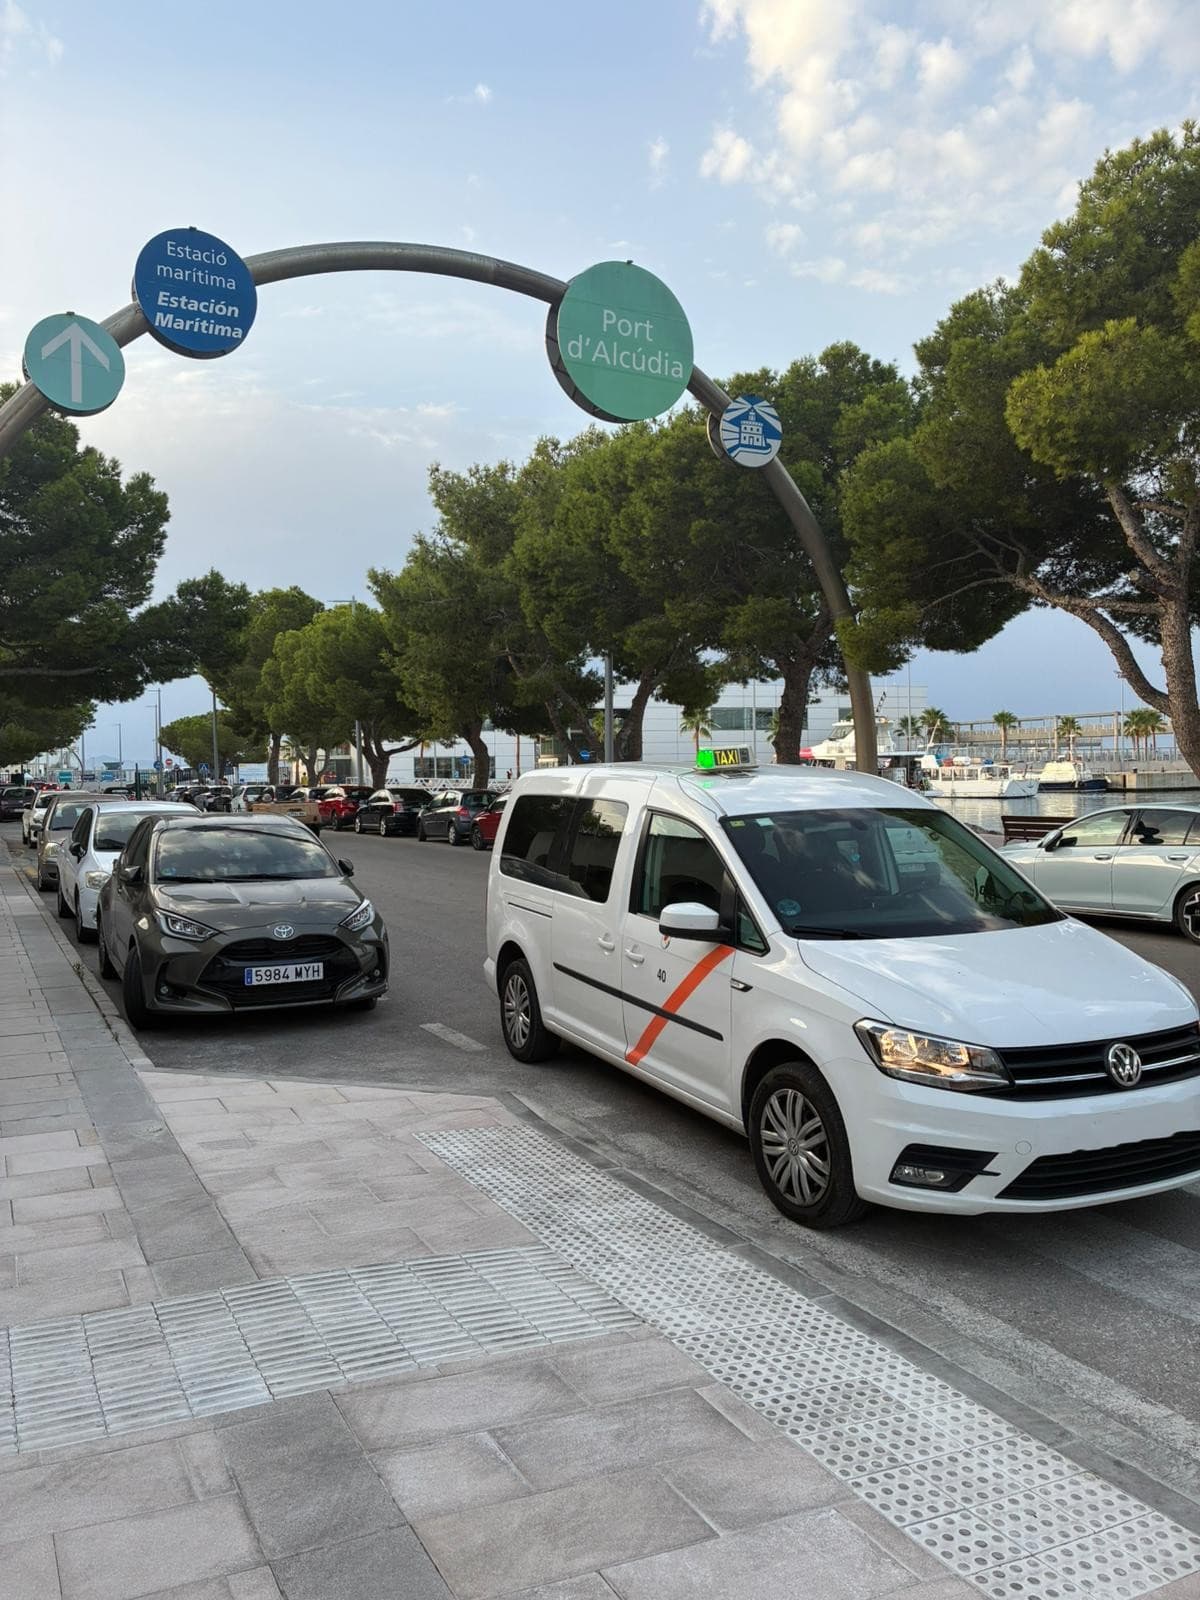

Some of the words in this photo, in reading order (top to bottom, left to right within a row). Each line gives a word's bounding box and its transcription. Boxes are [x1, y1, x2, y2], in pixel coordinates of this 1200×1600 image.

[167, 241, 228, 266] Estació
[157, 264, 236, 290] marítima
[157, 291, 240, 318] Estación
[155, 312, 243, 338] Marítima
[603, 309, 654, 342] Port
[567, 335, 684, 378] d'Alcúdia
[714, 750, 739, 765] TAXI
[255, 968, 290, 982] 5984
[295, 964, 320, 980] MYH
[657, 968, 666, 983] 40
